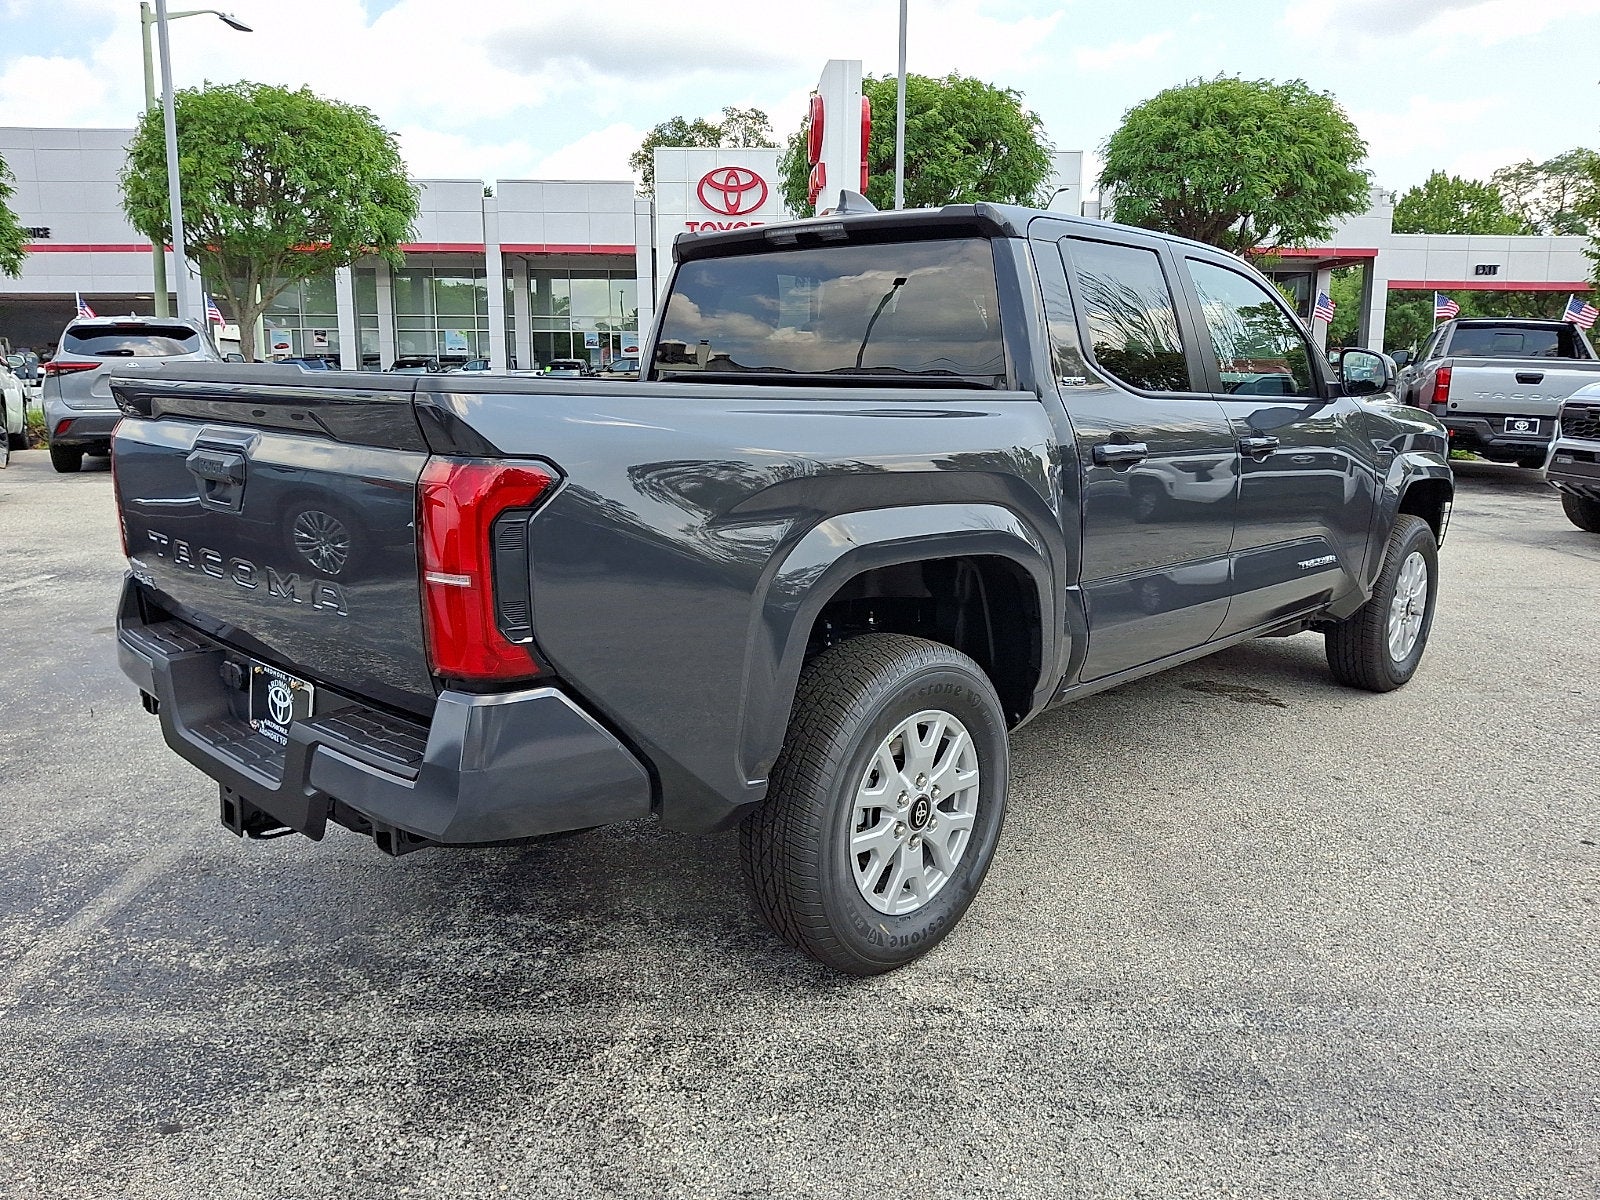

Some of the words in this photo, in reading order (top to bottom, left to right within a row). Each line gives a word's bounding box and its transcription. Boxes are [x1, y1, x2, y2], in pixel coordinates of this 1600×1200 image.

[685, 221, 765, 233] TOYO
[1475, 264, 1501, 276] EXIT
[1473, 390, 1563, 402] TACOM
[147, 529, 349, 617] TACOMA
